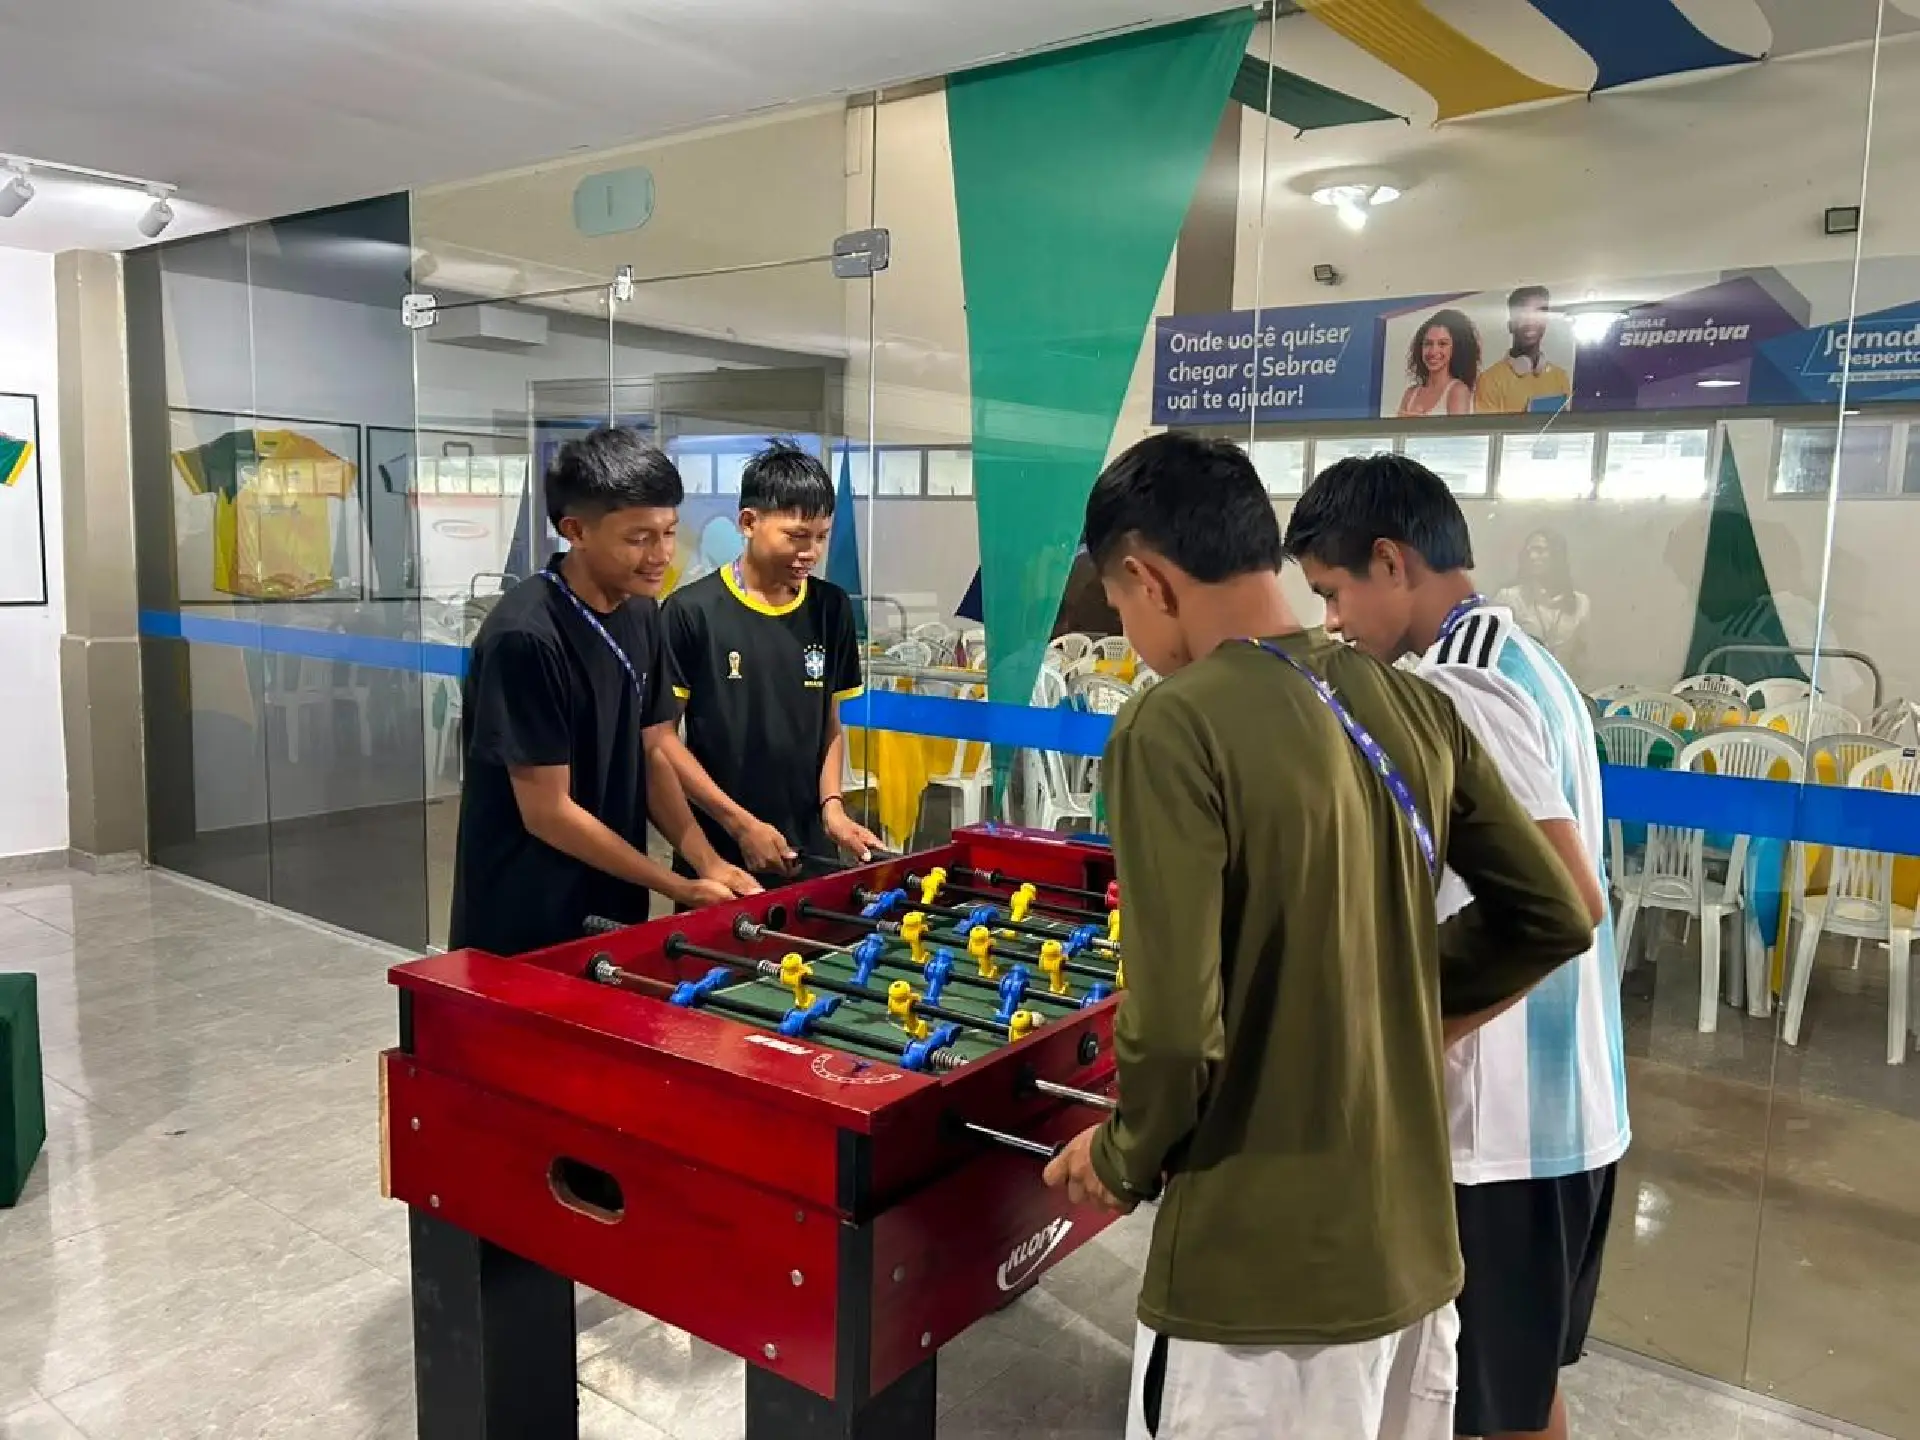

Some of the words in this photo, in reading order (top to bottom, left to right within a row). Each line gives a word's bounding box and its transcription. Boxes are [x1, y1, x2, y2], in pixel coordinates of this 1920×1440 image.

[1170, 331, 1223, 353] Onde
[1281, 323, 1350, 351] quiser
[1168, 361, 1238, 385] chegar
[1261, 354, 1337, 376] Sebrae
[1203, 391, 1223, 409] te
[1227, 384, 1304, 412] ajudar!
